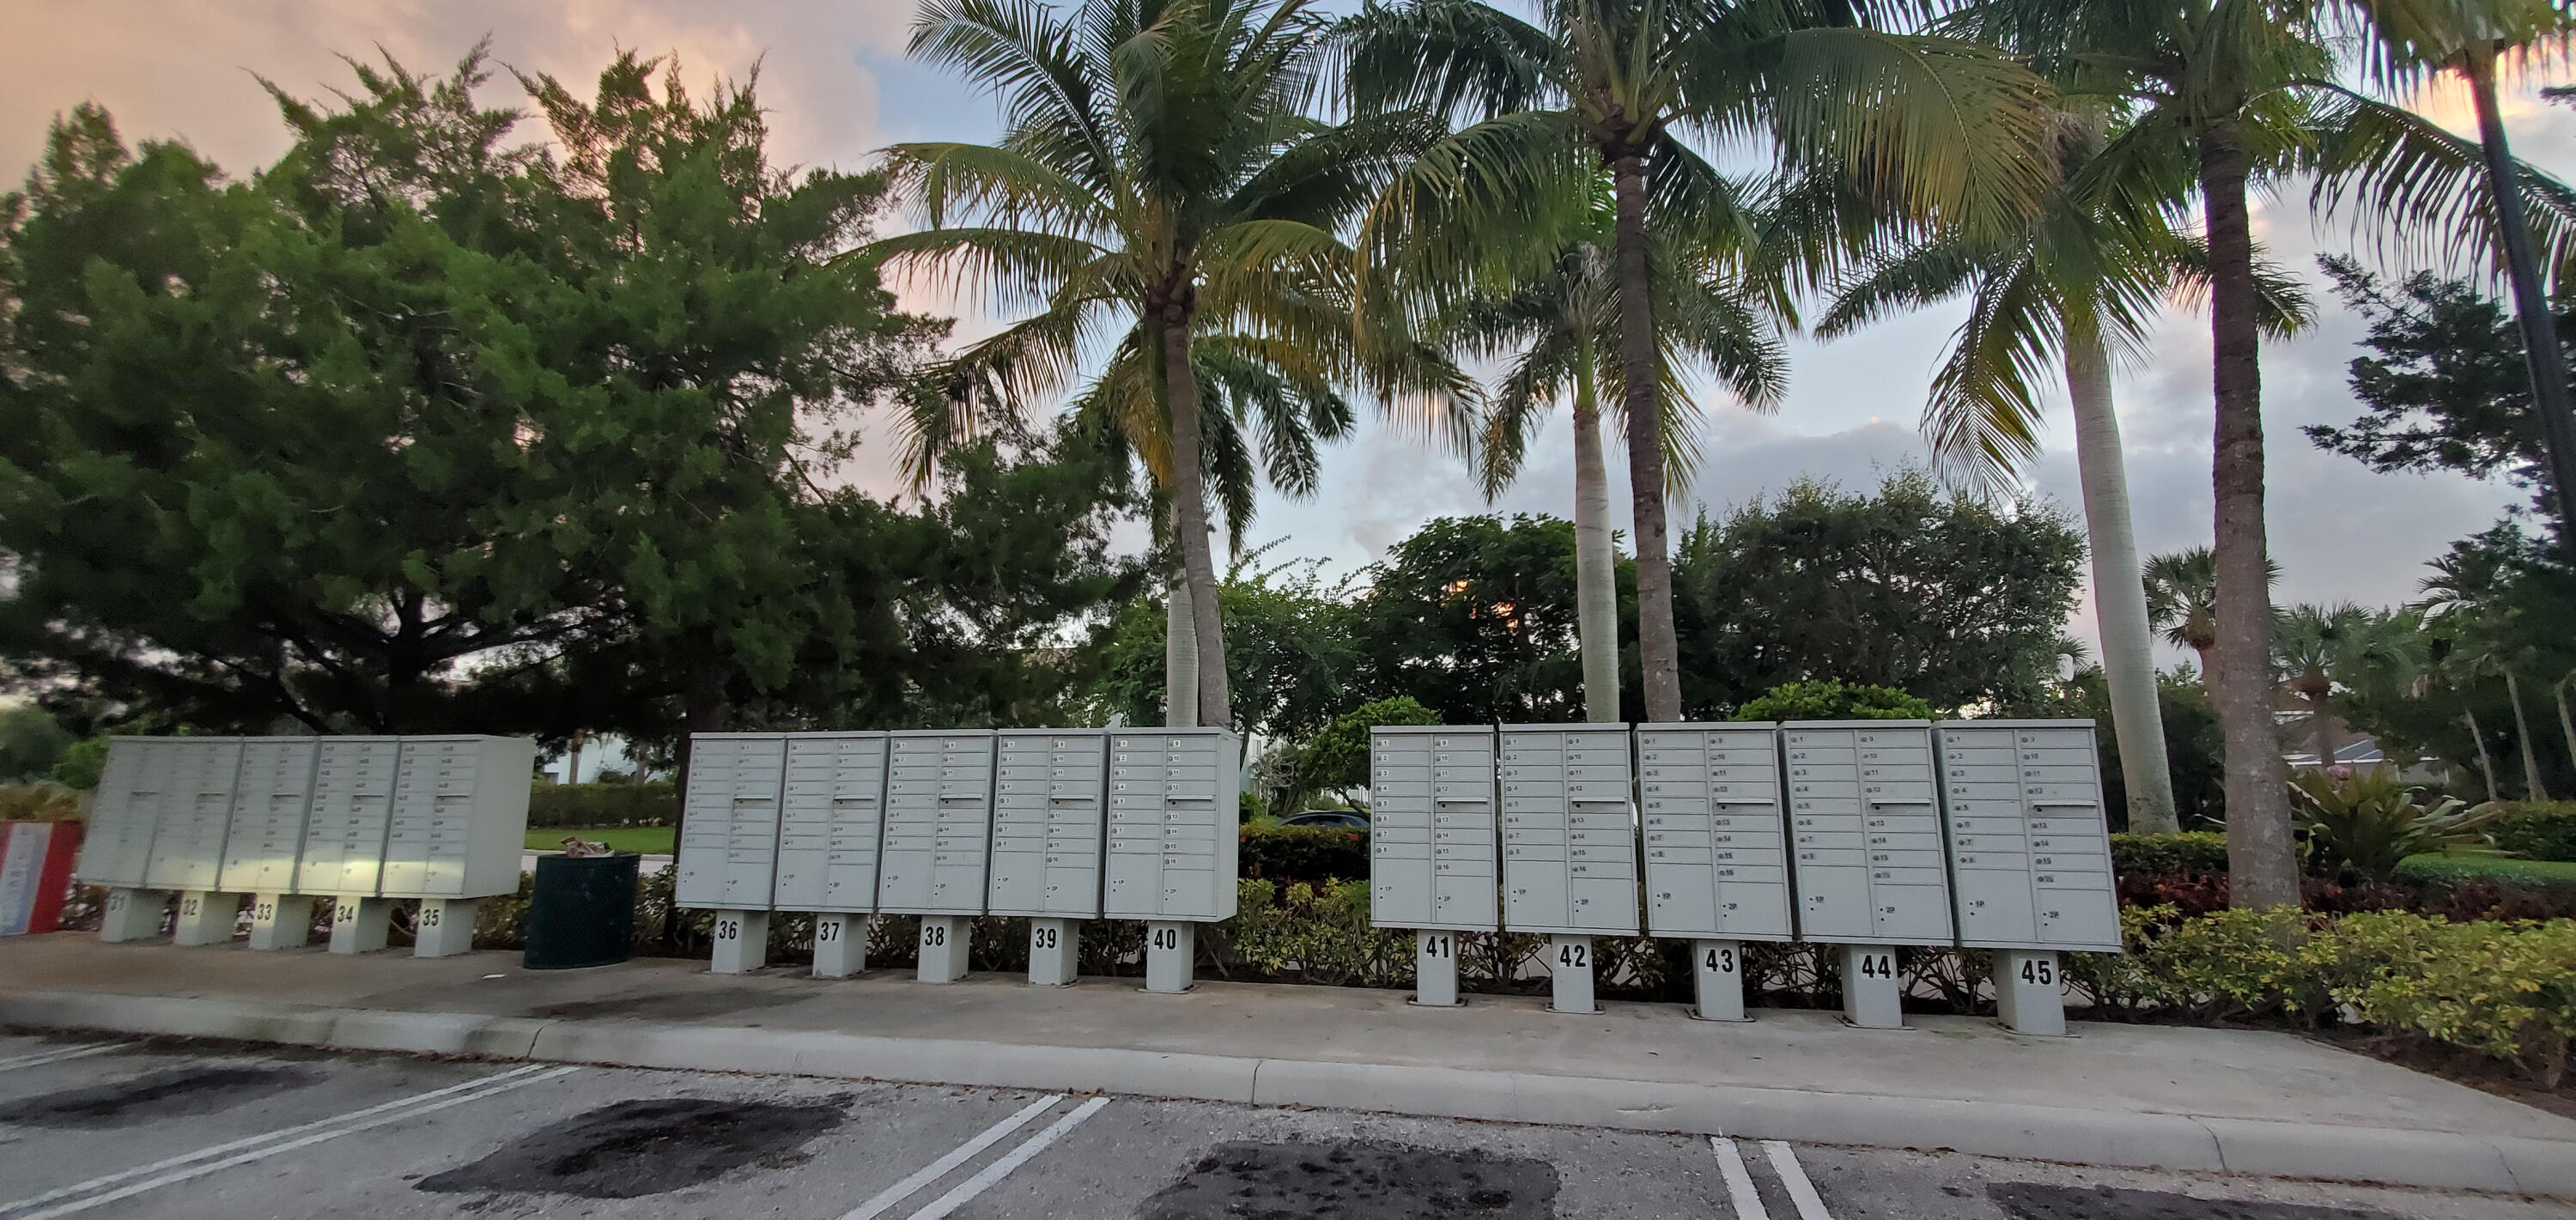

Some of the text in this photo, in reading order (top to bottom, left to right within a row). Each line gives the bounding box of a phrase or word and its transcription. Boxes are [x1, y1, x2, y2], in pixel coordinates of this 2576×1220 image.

[183, 899, 197, 915] 32
[257, 904, 271, 920] 33
[337, 906, 353, 922] 34
[423, 909, 439, 926] 35
[720, 920, 737, 939] 36
[821, 922, 839, 941] 37
[925, 926, 944, 946] 38
[1036, 928, 1056, 948] 39
[1155, 929, 1176, 950] 40
[1427, 936, 1449, 957] 41
[1560, 945, 1586, 967] 42
[1706, 950, 1733, 972] 43
[1862, 955, 1891, 979] 44
[2022, 961, 2051, 985] 45
